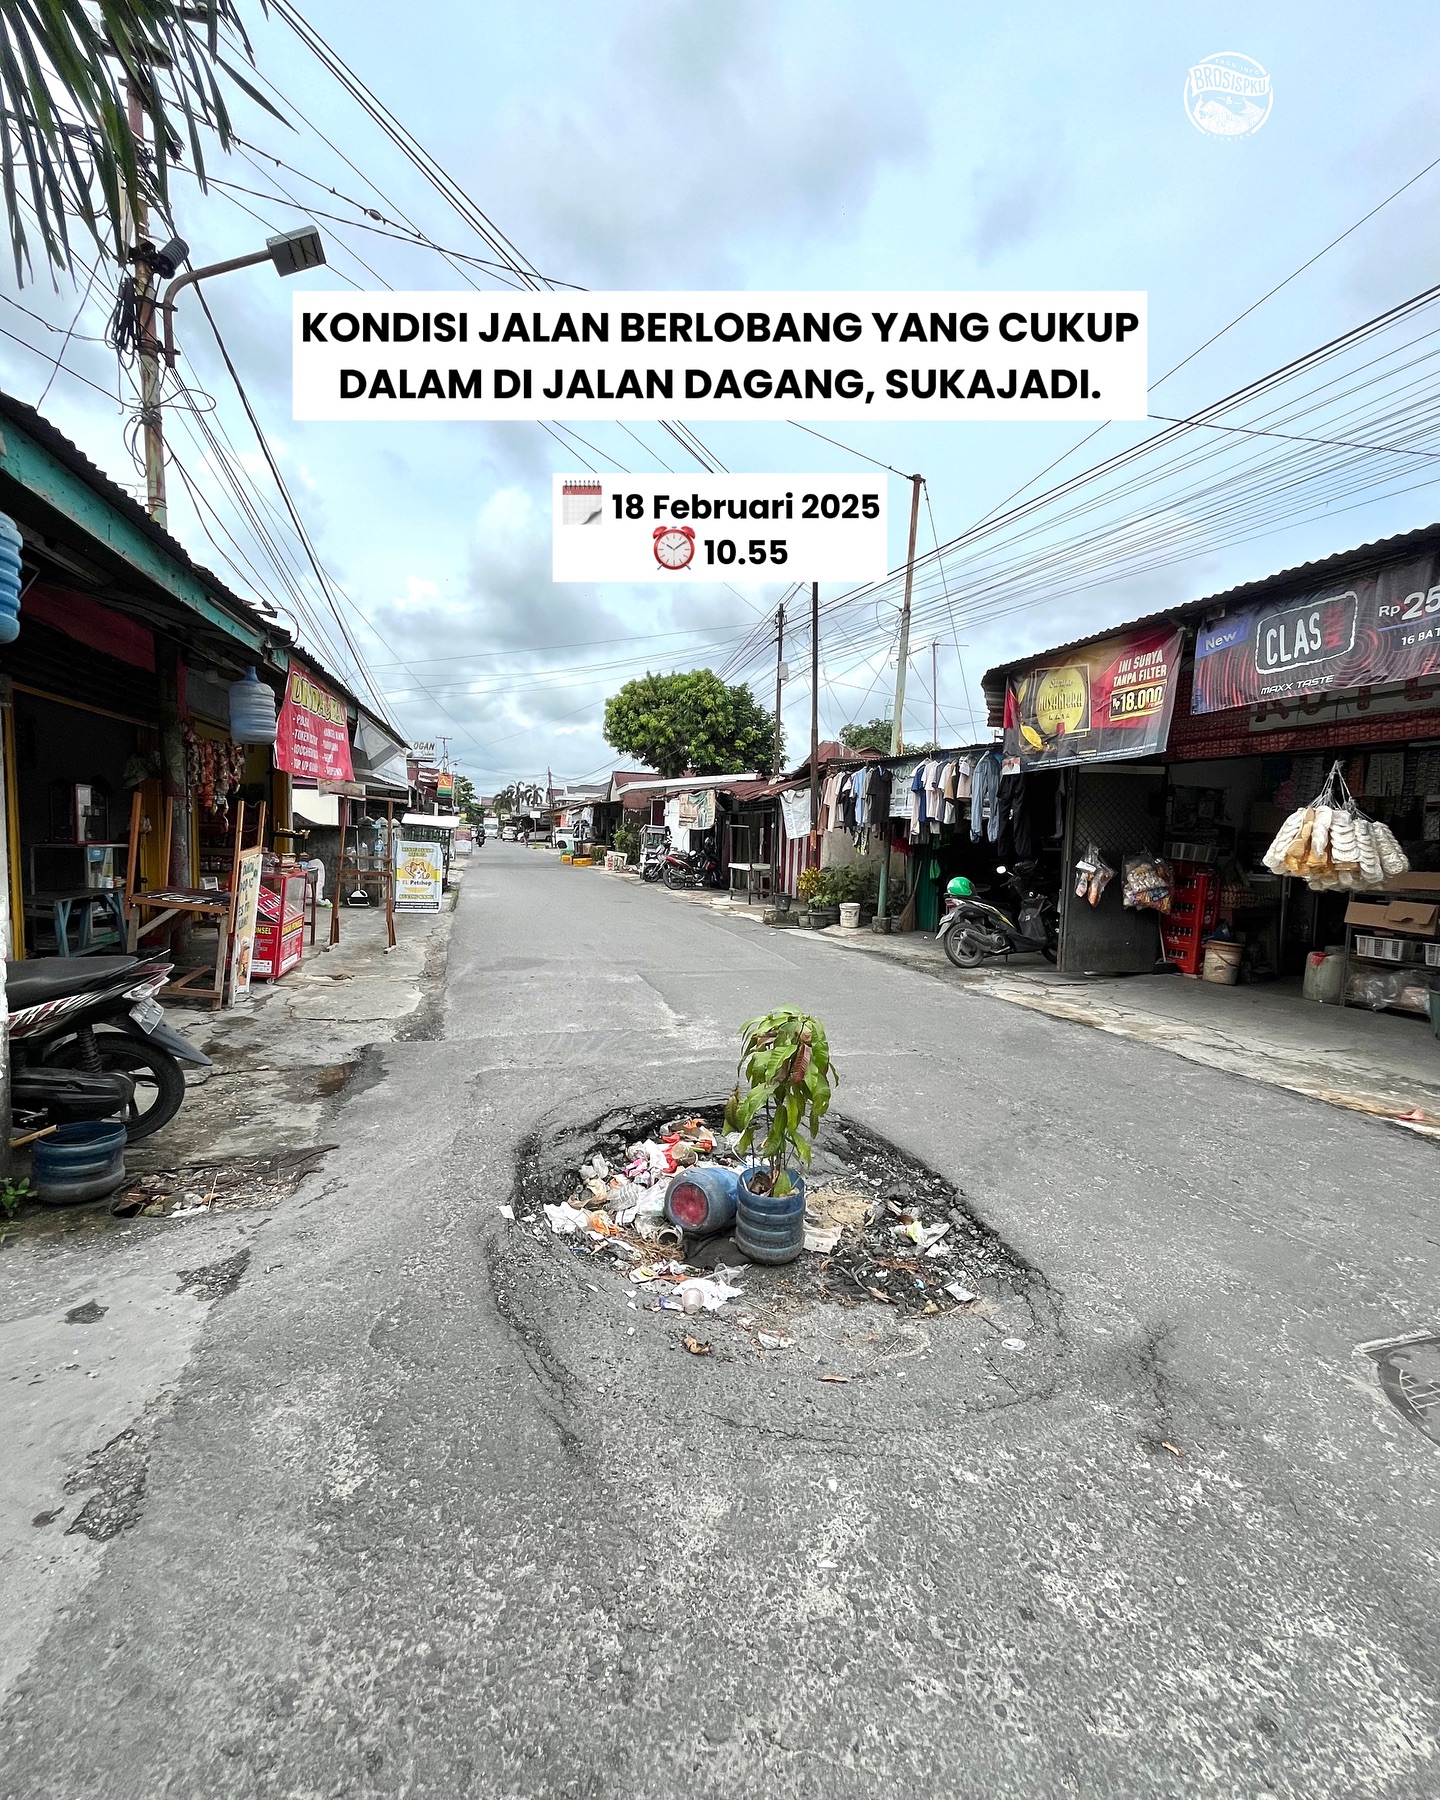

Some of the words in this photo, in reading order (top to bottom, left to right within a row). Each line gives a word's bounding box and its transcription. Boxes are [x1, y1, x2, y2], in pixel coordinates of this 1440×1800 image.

[1205, 630, 1237, 650] New
[1266, 611, 1322, 665] CLAS
[1401, 635, 1415, 646] 16
[1118, 659, 1132, 674] INI
[1134, 650, 1164, 670] SURYA
[1113, 672, 1137, 687] TANPA
[1139, 665, 1167, 682] FILTER
[1261, 682, 1293, 695] MAXX
[1296, 674, 1335, 690] TASTE
